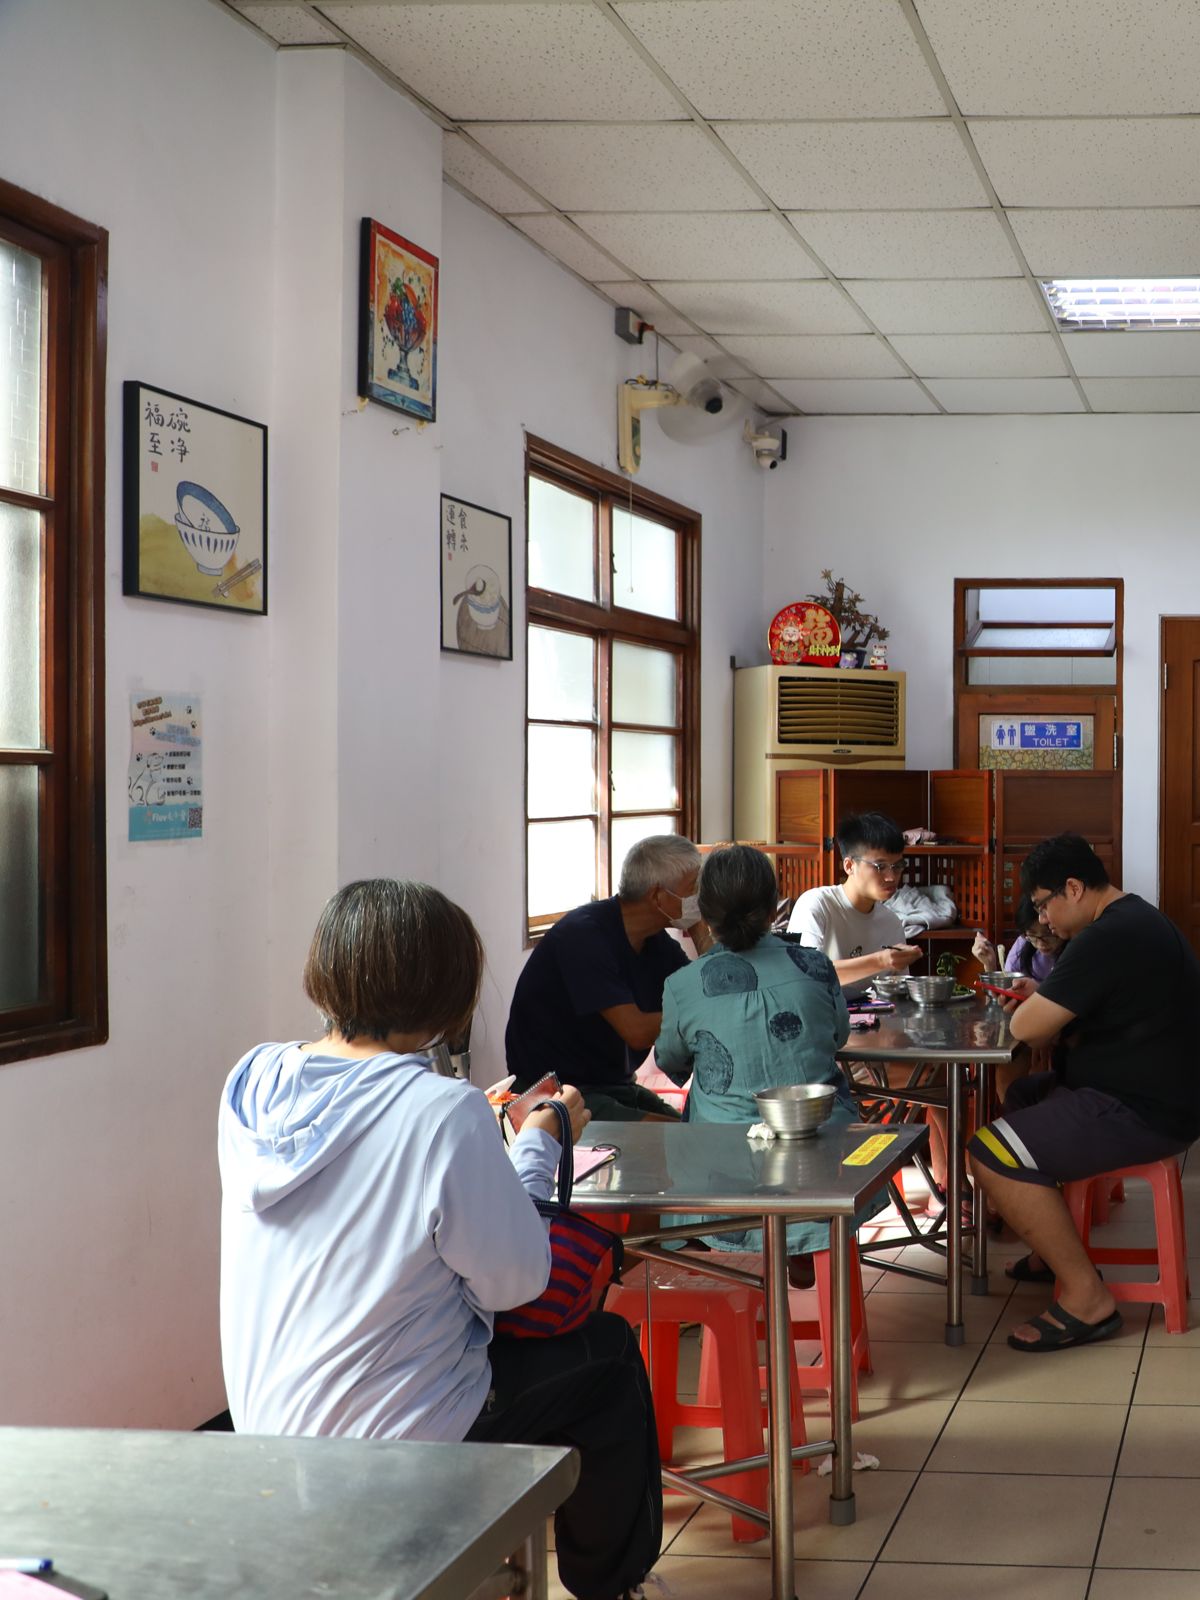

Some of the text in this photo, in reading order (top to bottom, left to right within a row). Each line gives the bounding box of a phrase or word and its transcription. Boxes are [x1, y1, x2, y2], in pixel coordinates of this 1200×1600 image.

[144, 401, 164, 456] 福至
[1024, 724, 1078, 737] 盥洗室
[1032, 737, 1070, 748] TOILET
